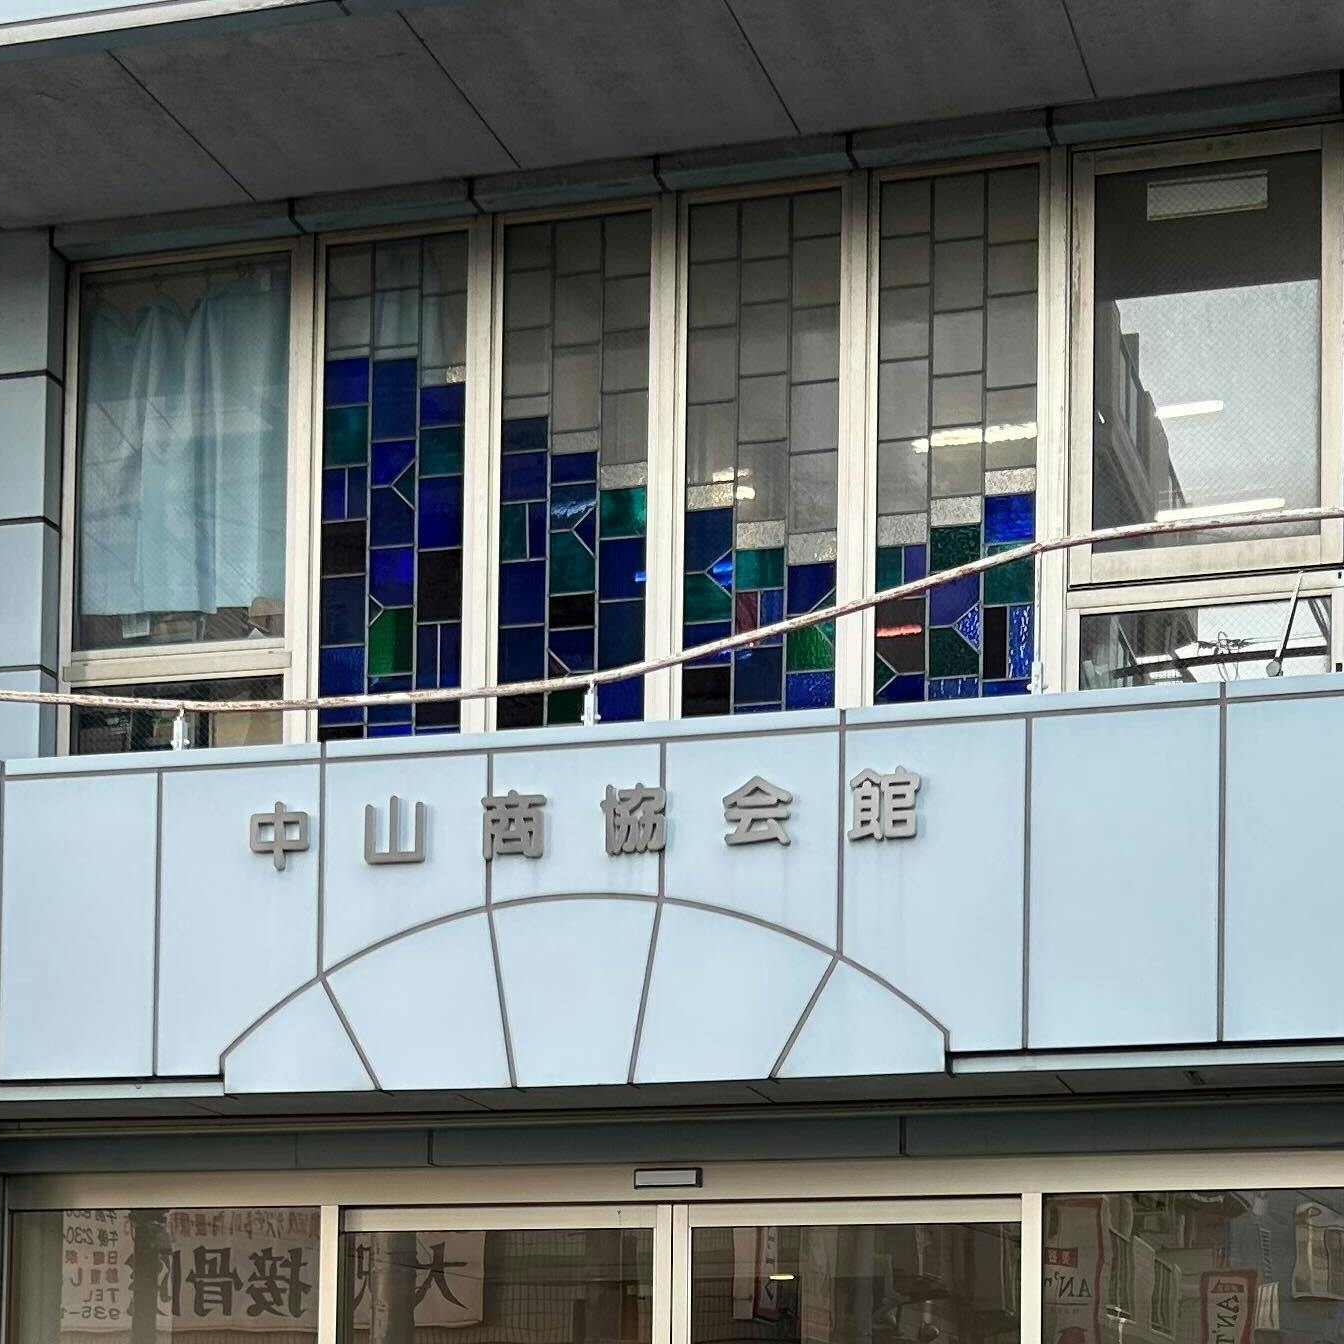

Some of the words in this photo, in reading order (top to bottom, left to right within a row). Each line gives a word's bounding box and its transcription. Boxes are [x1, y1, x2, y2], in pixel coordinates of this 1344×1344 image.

[249, 765, 922, 871] 中山商協会館
